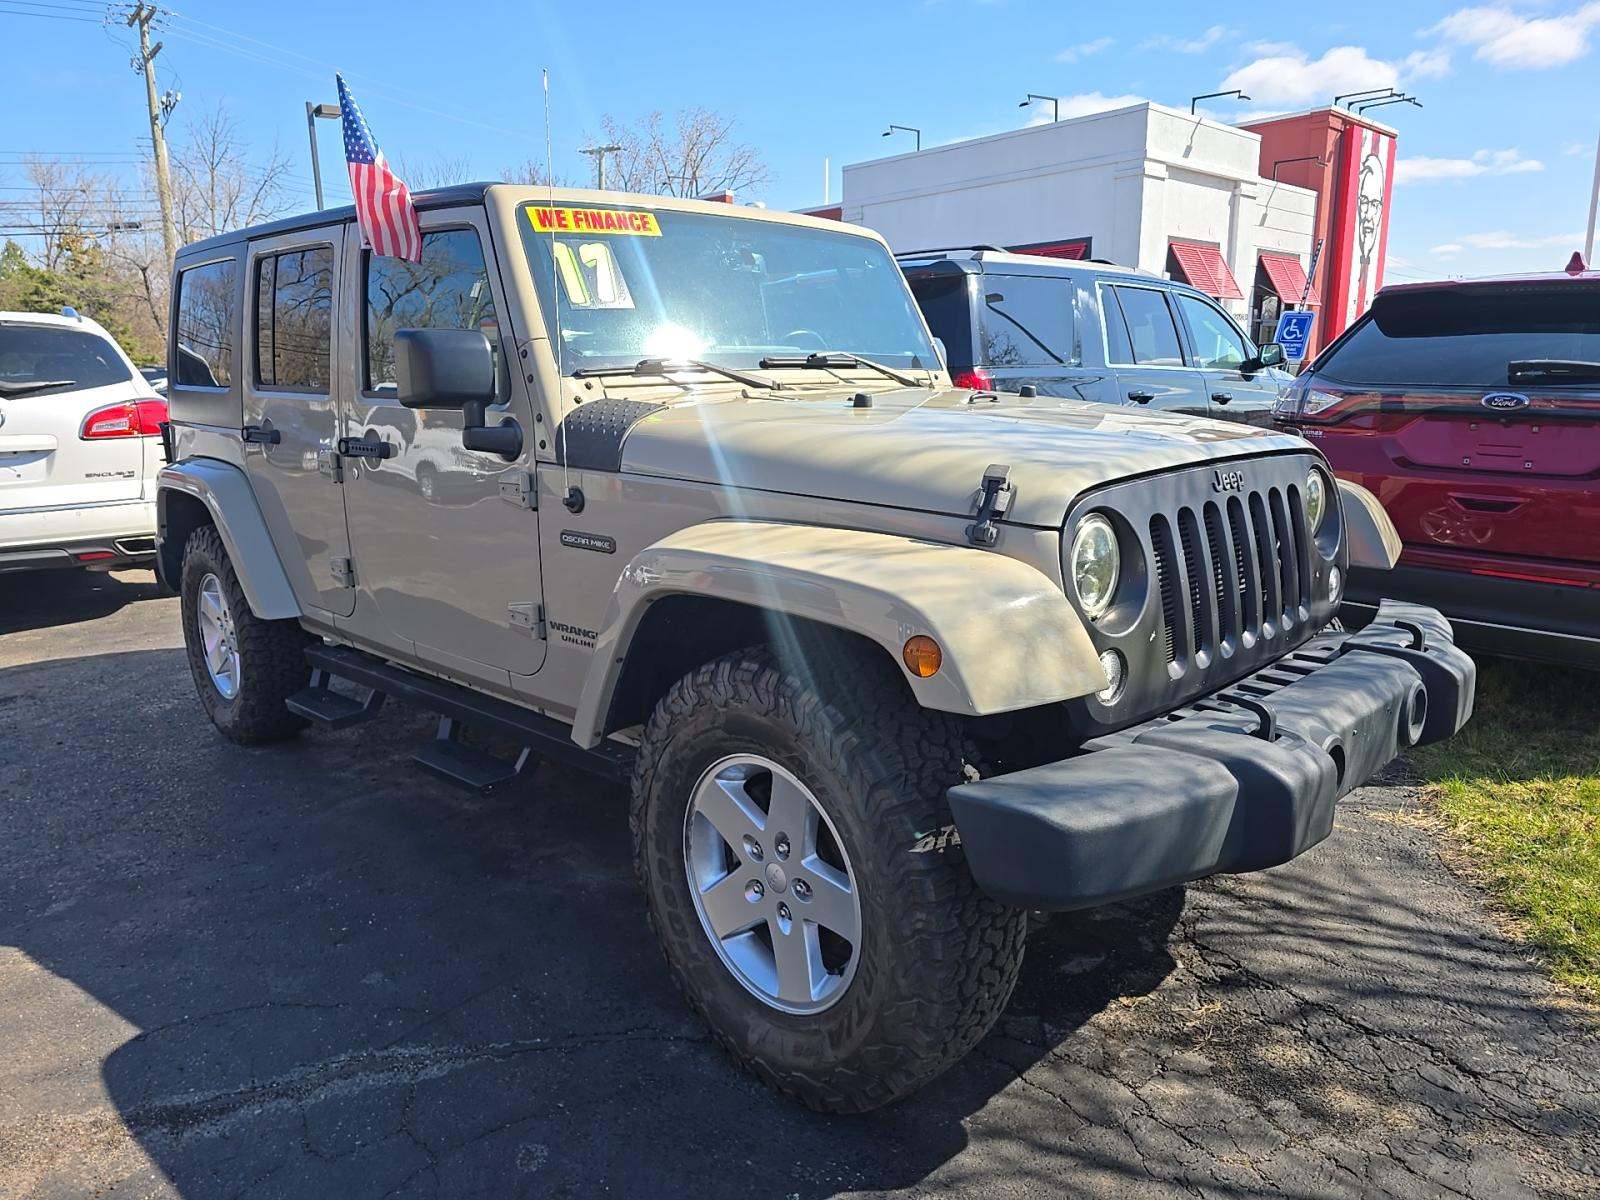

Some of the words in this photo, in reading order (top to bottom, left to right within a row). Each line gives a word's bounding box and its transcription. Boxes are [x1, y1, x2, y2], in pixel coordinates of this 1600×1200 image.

[535, 208, 569, 229] WE
[572, 210, 653, 232] FINANCE
[552, 241, 620, 306] 17
[1491, 396, 1518, 407] Ford
[1211, 469, 1245, 493] Jeep
[562, 534, 589, 546] OSCAR
[590, 539, 611, 549] MIKE
